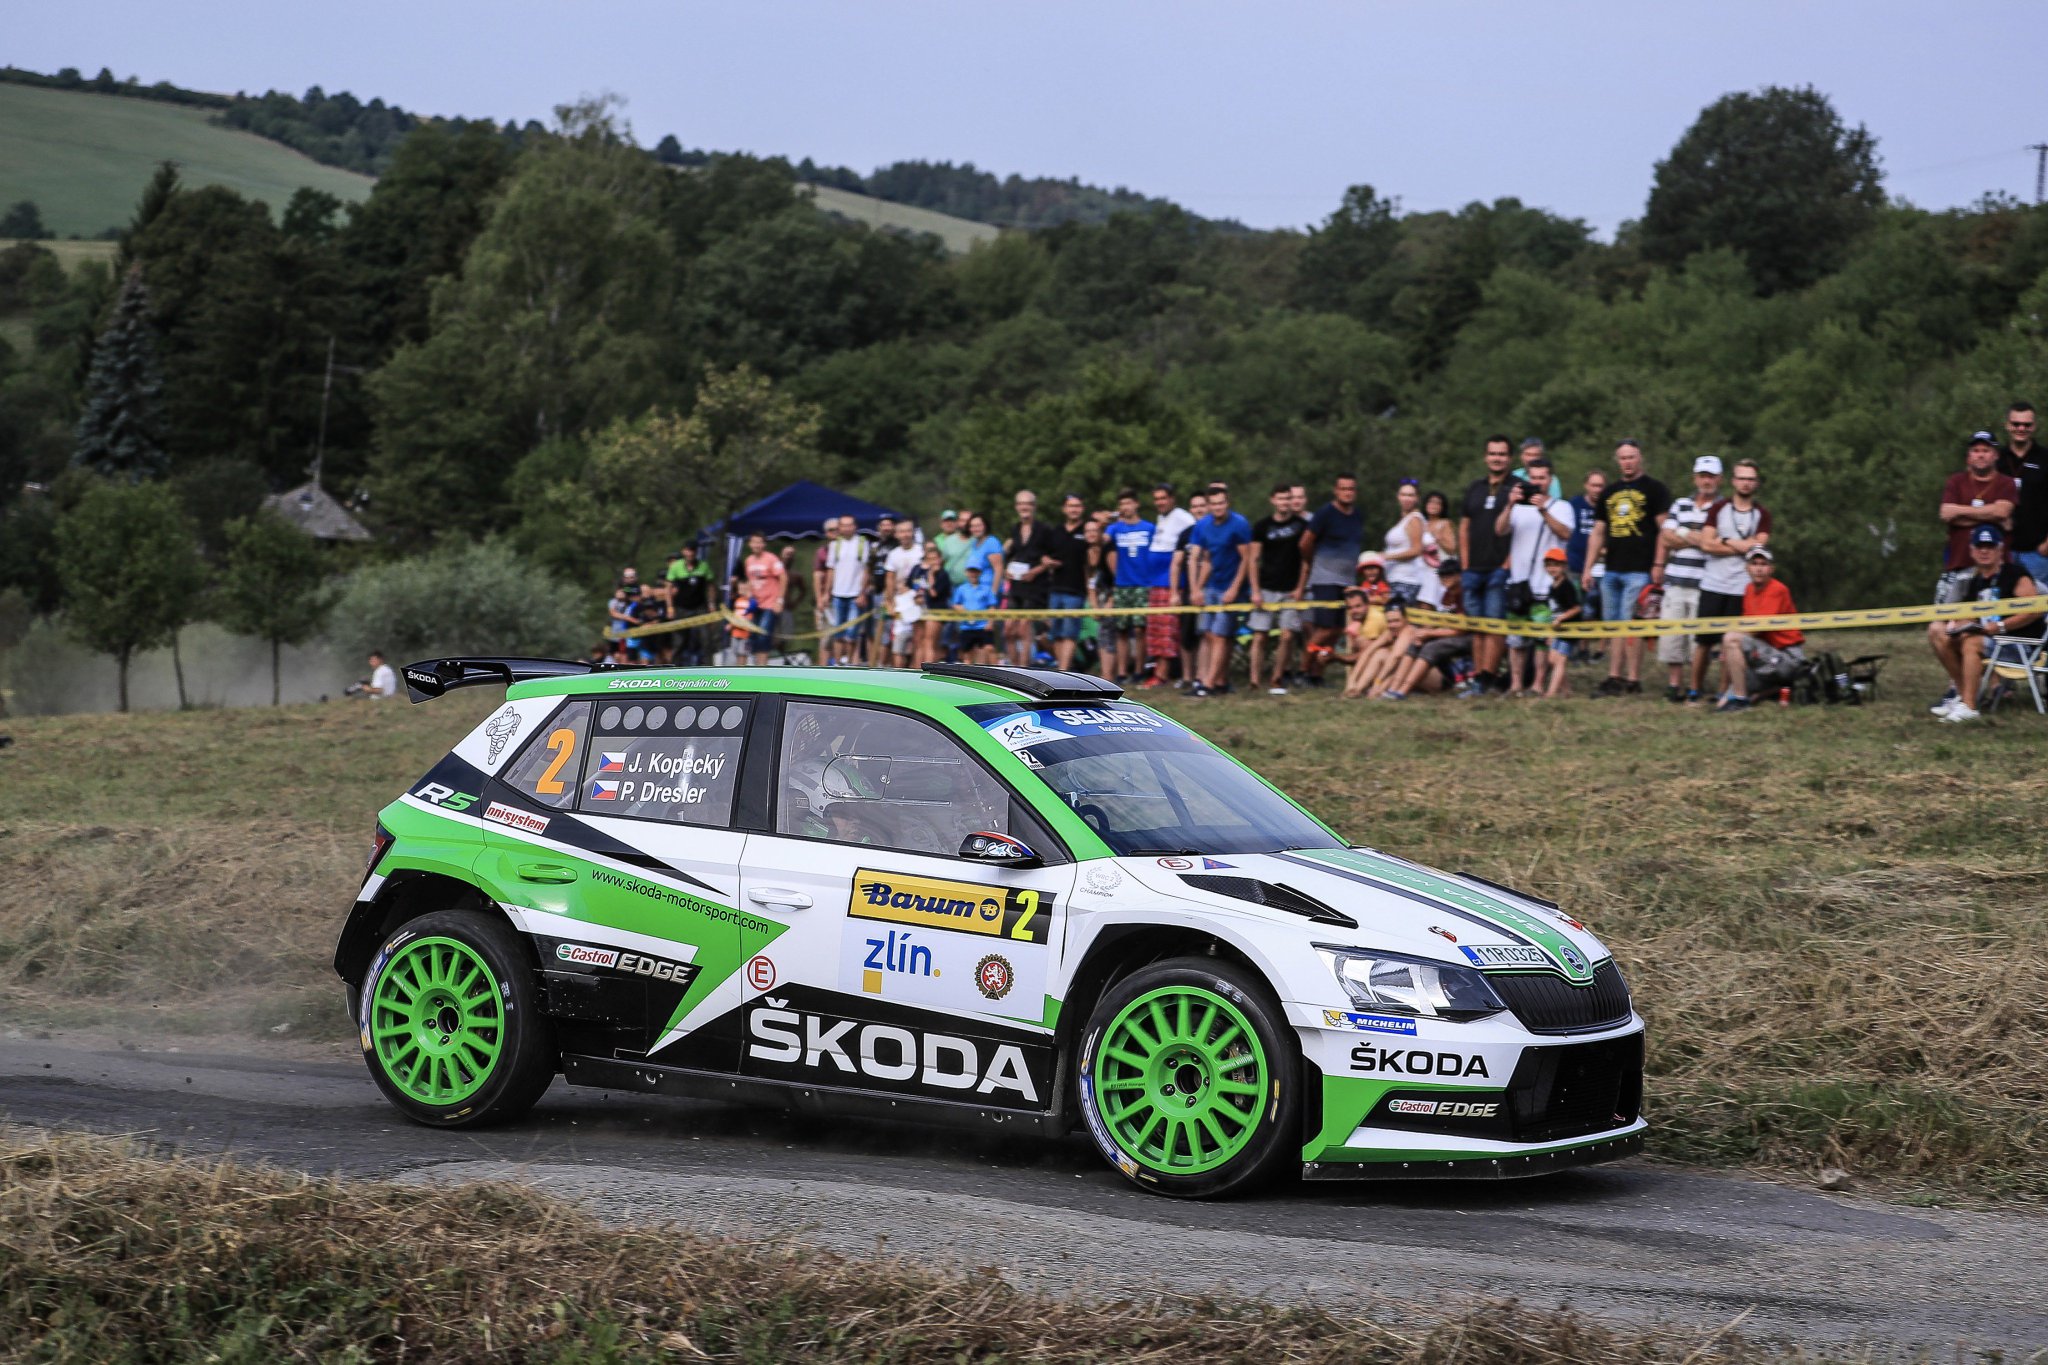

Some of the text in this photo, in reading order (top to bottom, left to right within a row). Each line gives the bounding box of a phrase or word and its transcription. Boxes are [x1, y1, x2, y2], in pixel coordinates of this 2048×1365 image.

[408, 670, 438, 685] ŠKODA
[608, 678, 661, 689] ŠKODA
[664, 679, 712, 690] Originální
[1052, 709, 1163, 727] SEAJETS
[535, 728, 576, 795] 2
[628, 752, 725, 780] J. Kopecký
[413, 781, 480, 812] R5
[620, 780, 706, 804] P. Dresler
[592, 868, 769, 934] www.skoda-motorsport.com
[860, 883, 976, 918] Barum
[1080, 887, 1114, 898] CHAMPION
[1011, 889, 1040, 941] 2
[570, 947, 694, 985] Castrol EDGE
[1356, 1017, 1415, 1030] MICHELIN
[749, 996, 1039, 1103] ŠKODA
[1350, 1041, 1490, 1079] ŠKODA
[1399, 1101, 1500, 1118] Castrol EDGE
